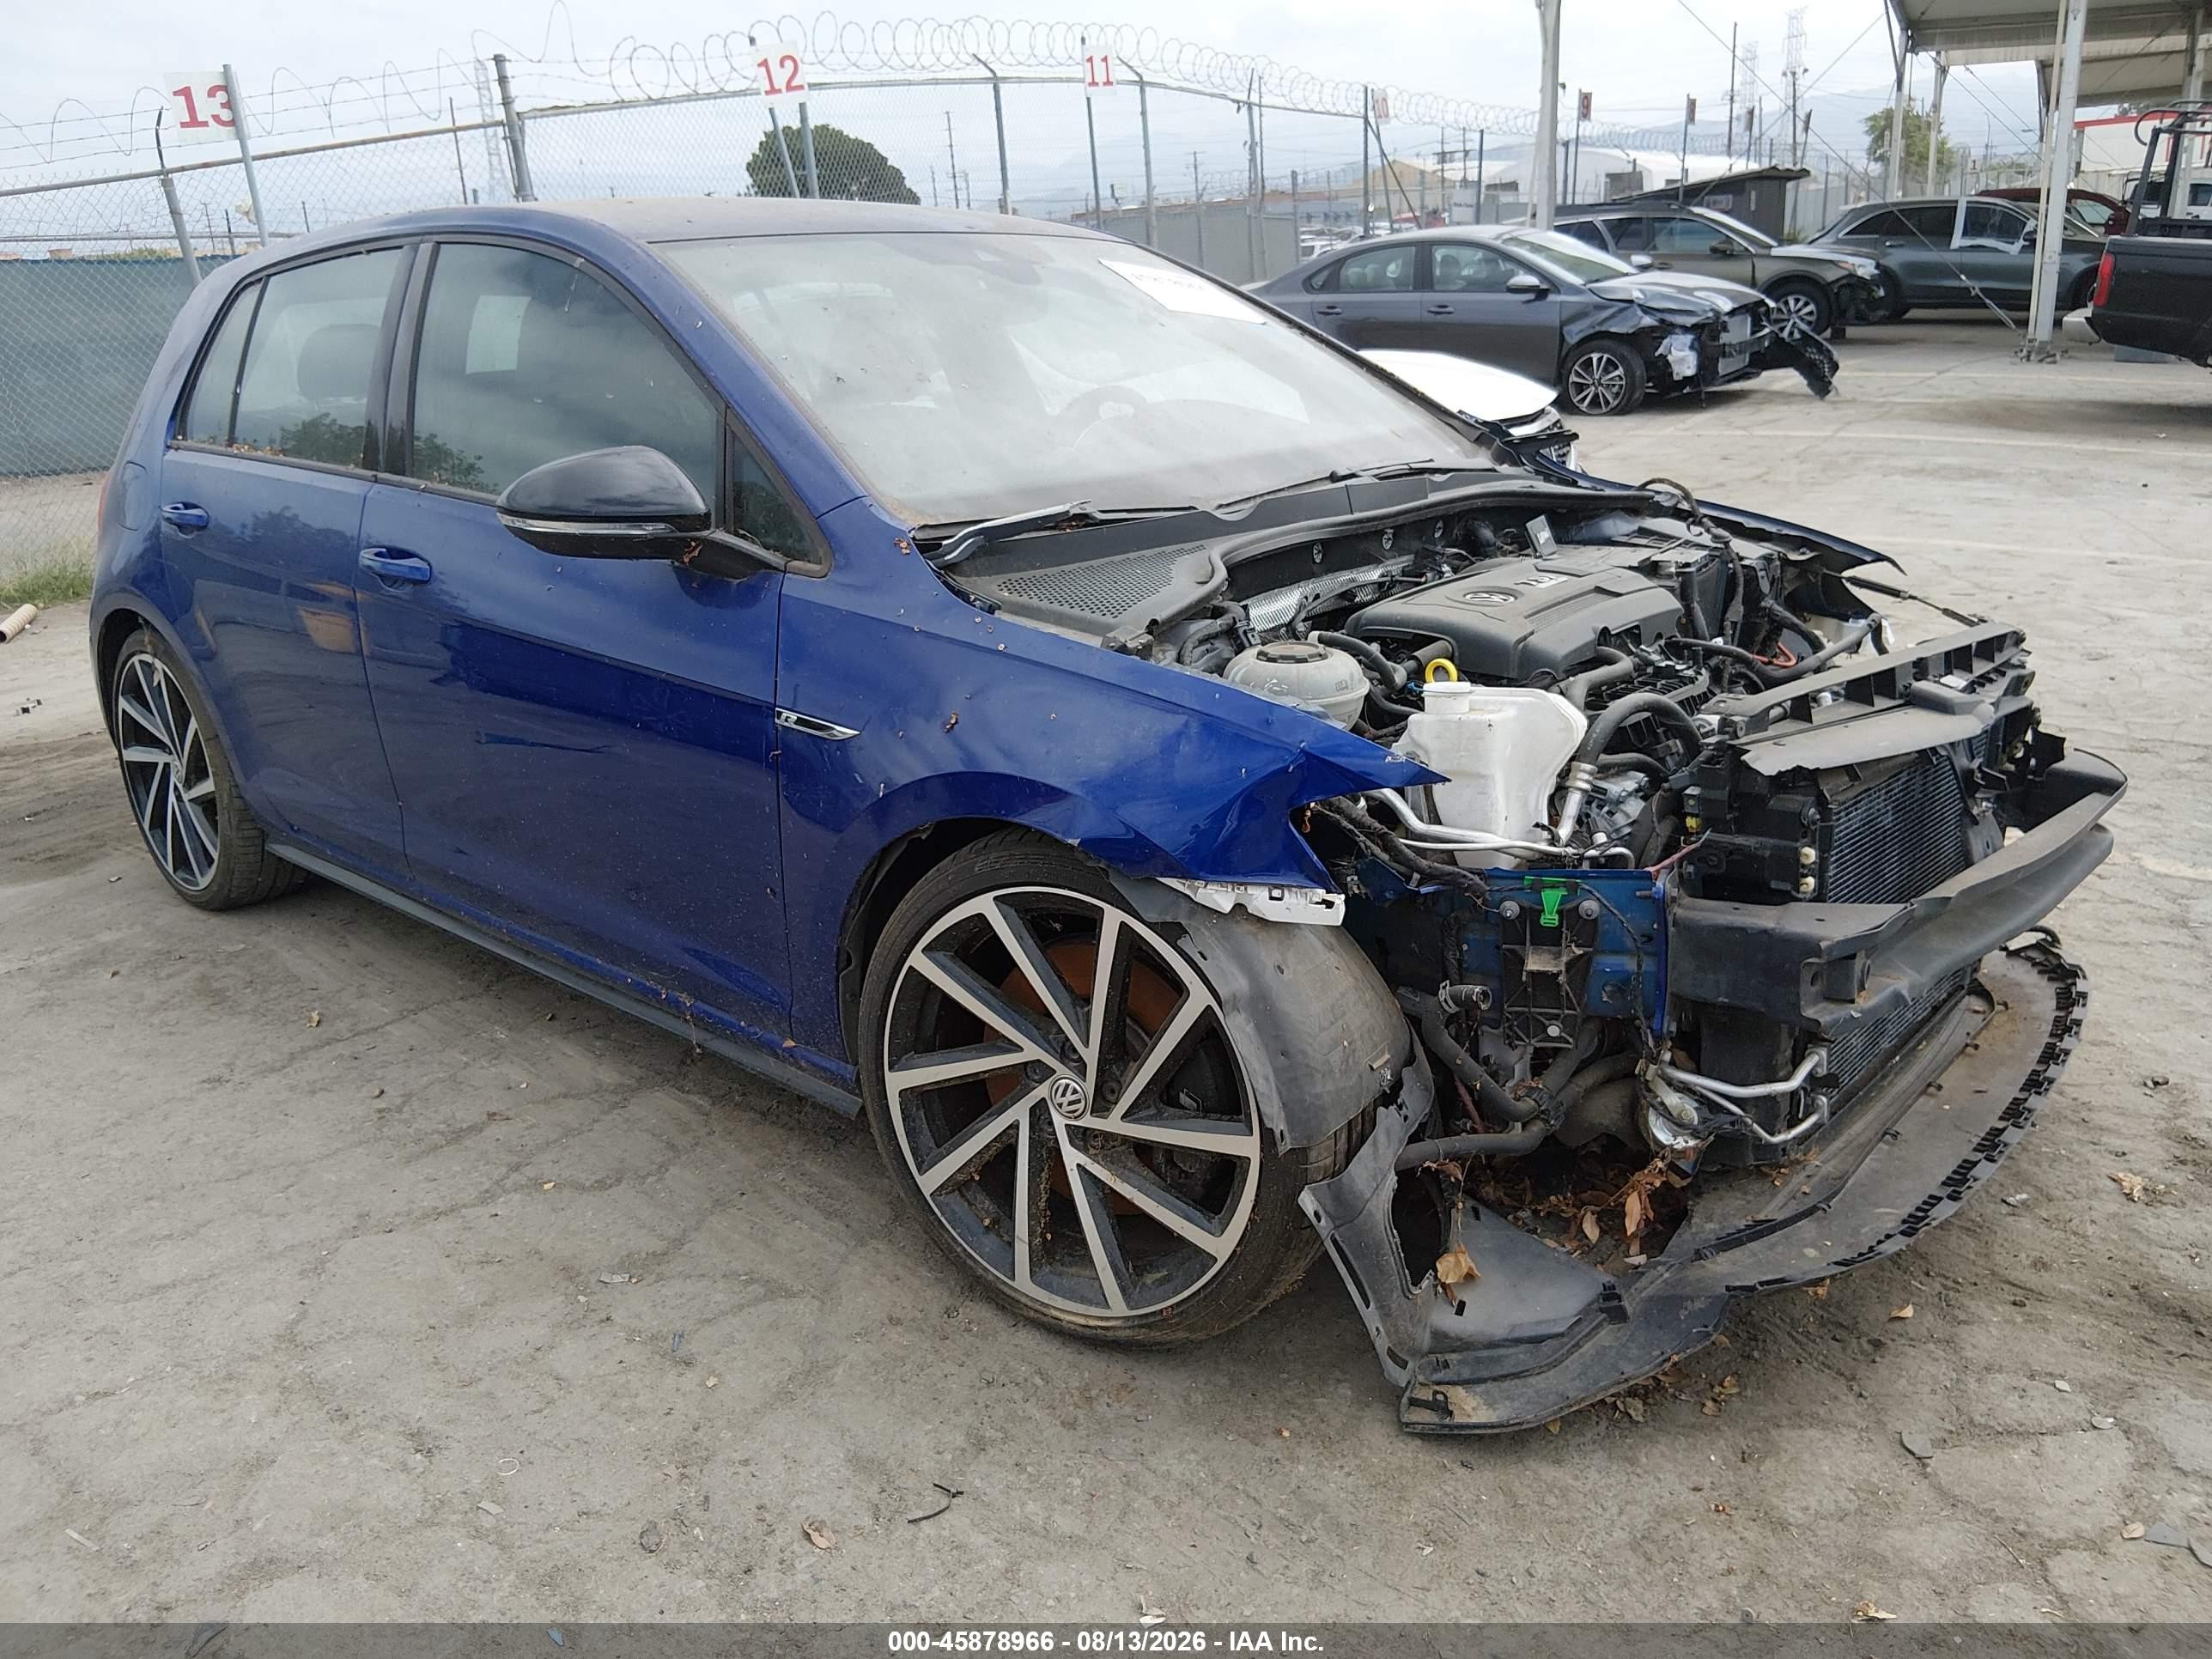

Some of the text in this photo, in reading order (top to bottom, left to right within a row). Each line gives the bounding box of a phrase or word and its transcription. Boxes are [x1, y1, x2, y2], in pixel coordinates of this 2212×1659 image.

[757, 55, 805, 95] 12
[1086, 55, 1114, 87] 11
[173, 84, 235, 129] 13
[1375, 97, 1389, 118] 10
[1582, 94, 1589, 118] 9
[781, 712, 798, 727] R
